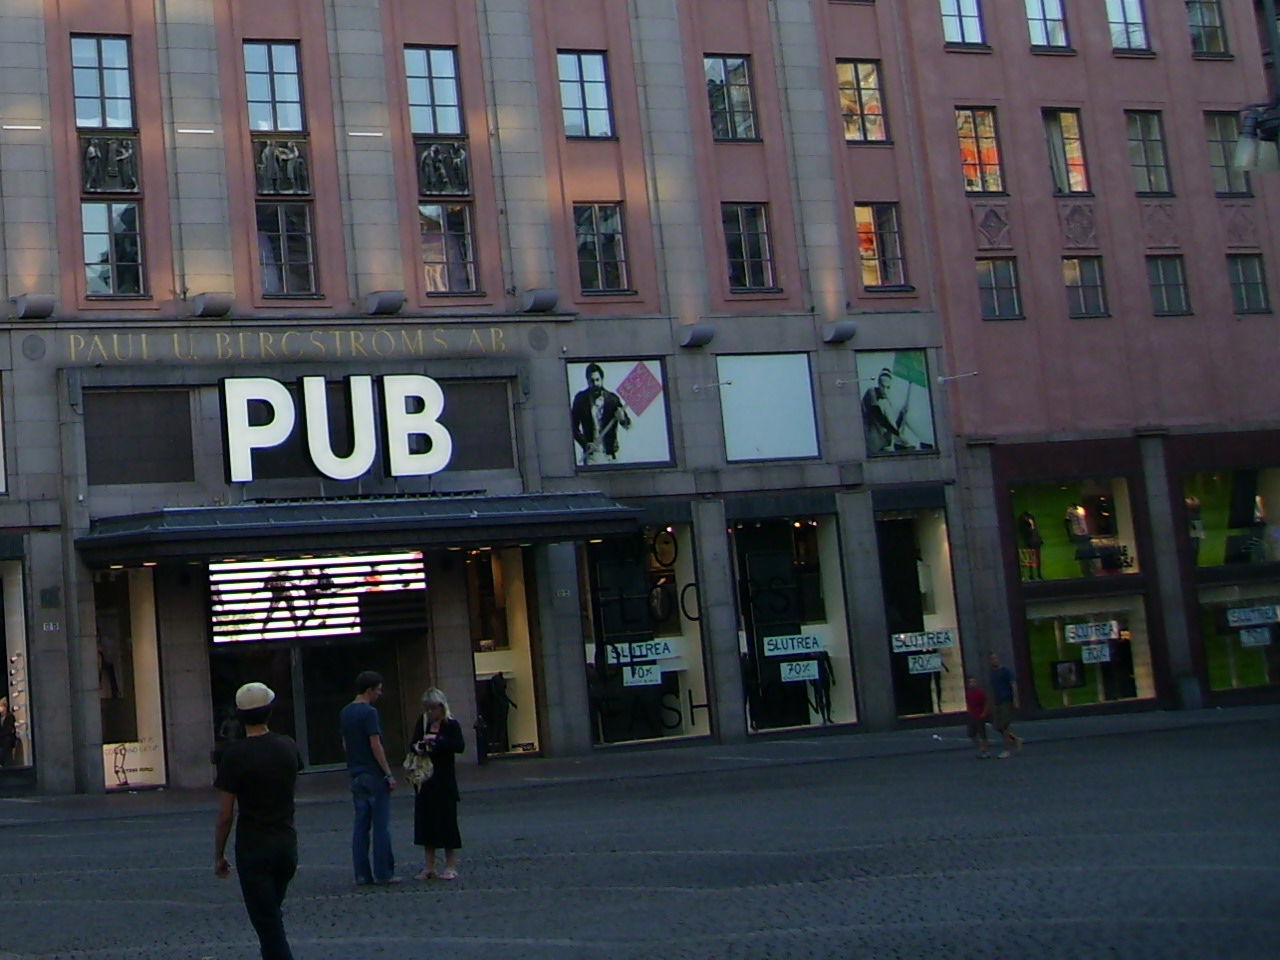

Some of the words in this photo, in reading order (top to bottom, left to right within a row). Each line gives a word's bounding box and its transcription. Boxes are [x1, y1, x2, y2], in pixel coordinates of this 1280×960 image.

[69, 333, 154, 362] PAUL
[221, 374, 453, 483] PUB
[767, 637, 819, 651] SLUTREA
[895, 631, 951, 649] SLUTREA
[786, 663, 811, 674] 70%
